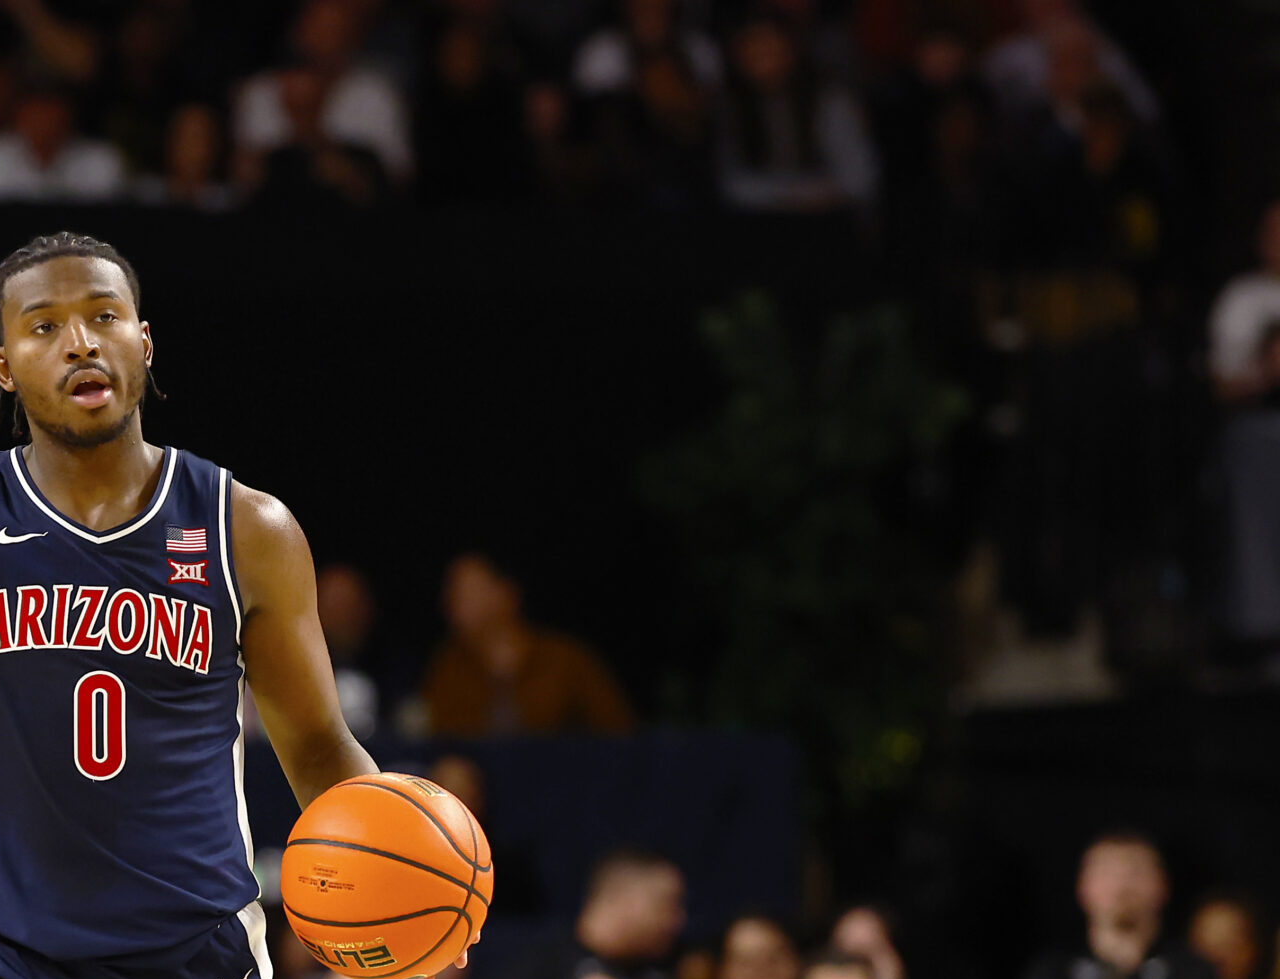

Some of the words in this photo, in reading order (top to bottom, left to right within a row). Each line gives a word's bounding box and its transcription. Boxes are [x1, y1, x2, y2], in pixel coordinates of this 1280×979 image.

[169, 560, 207, 583] XII
[73, 670, 127, 781] 0
[297, 933, 397, 968] ELITE
